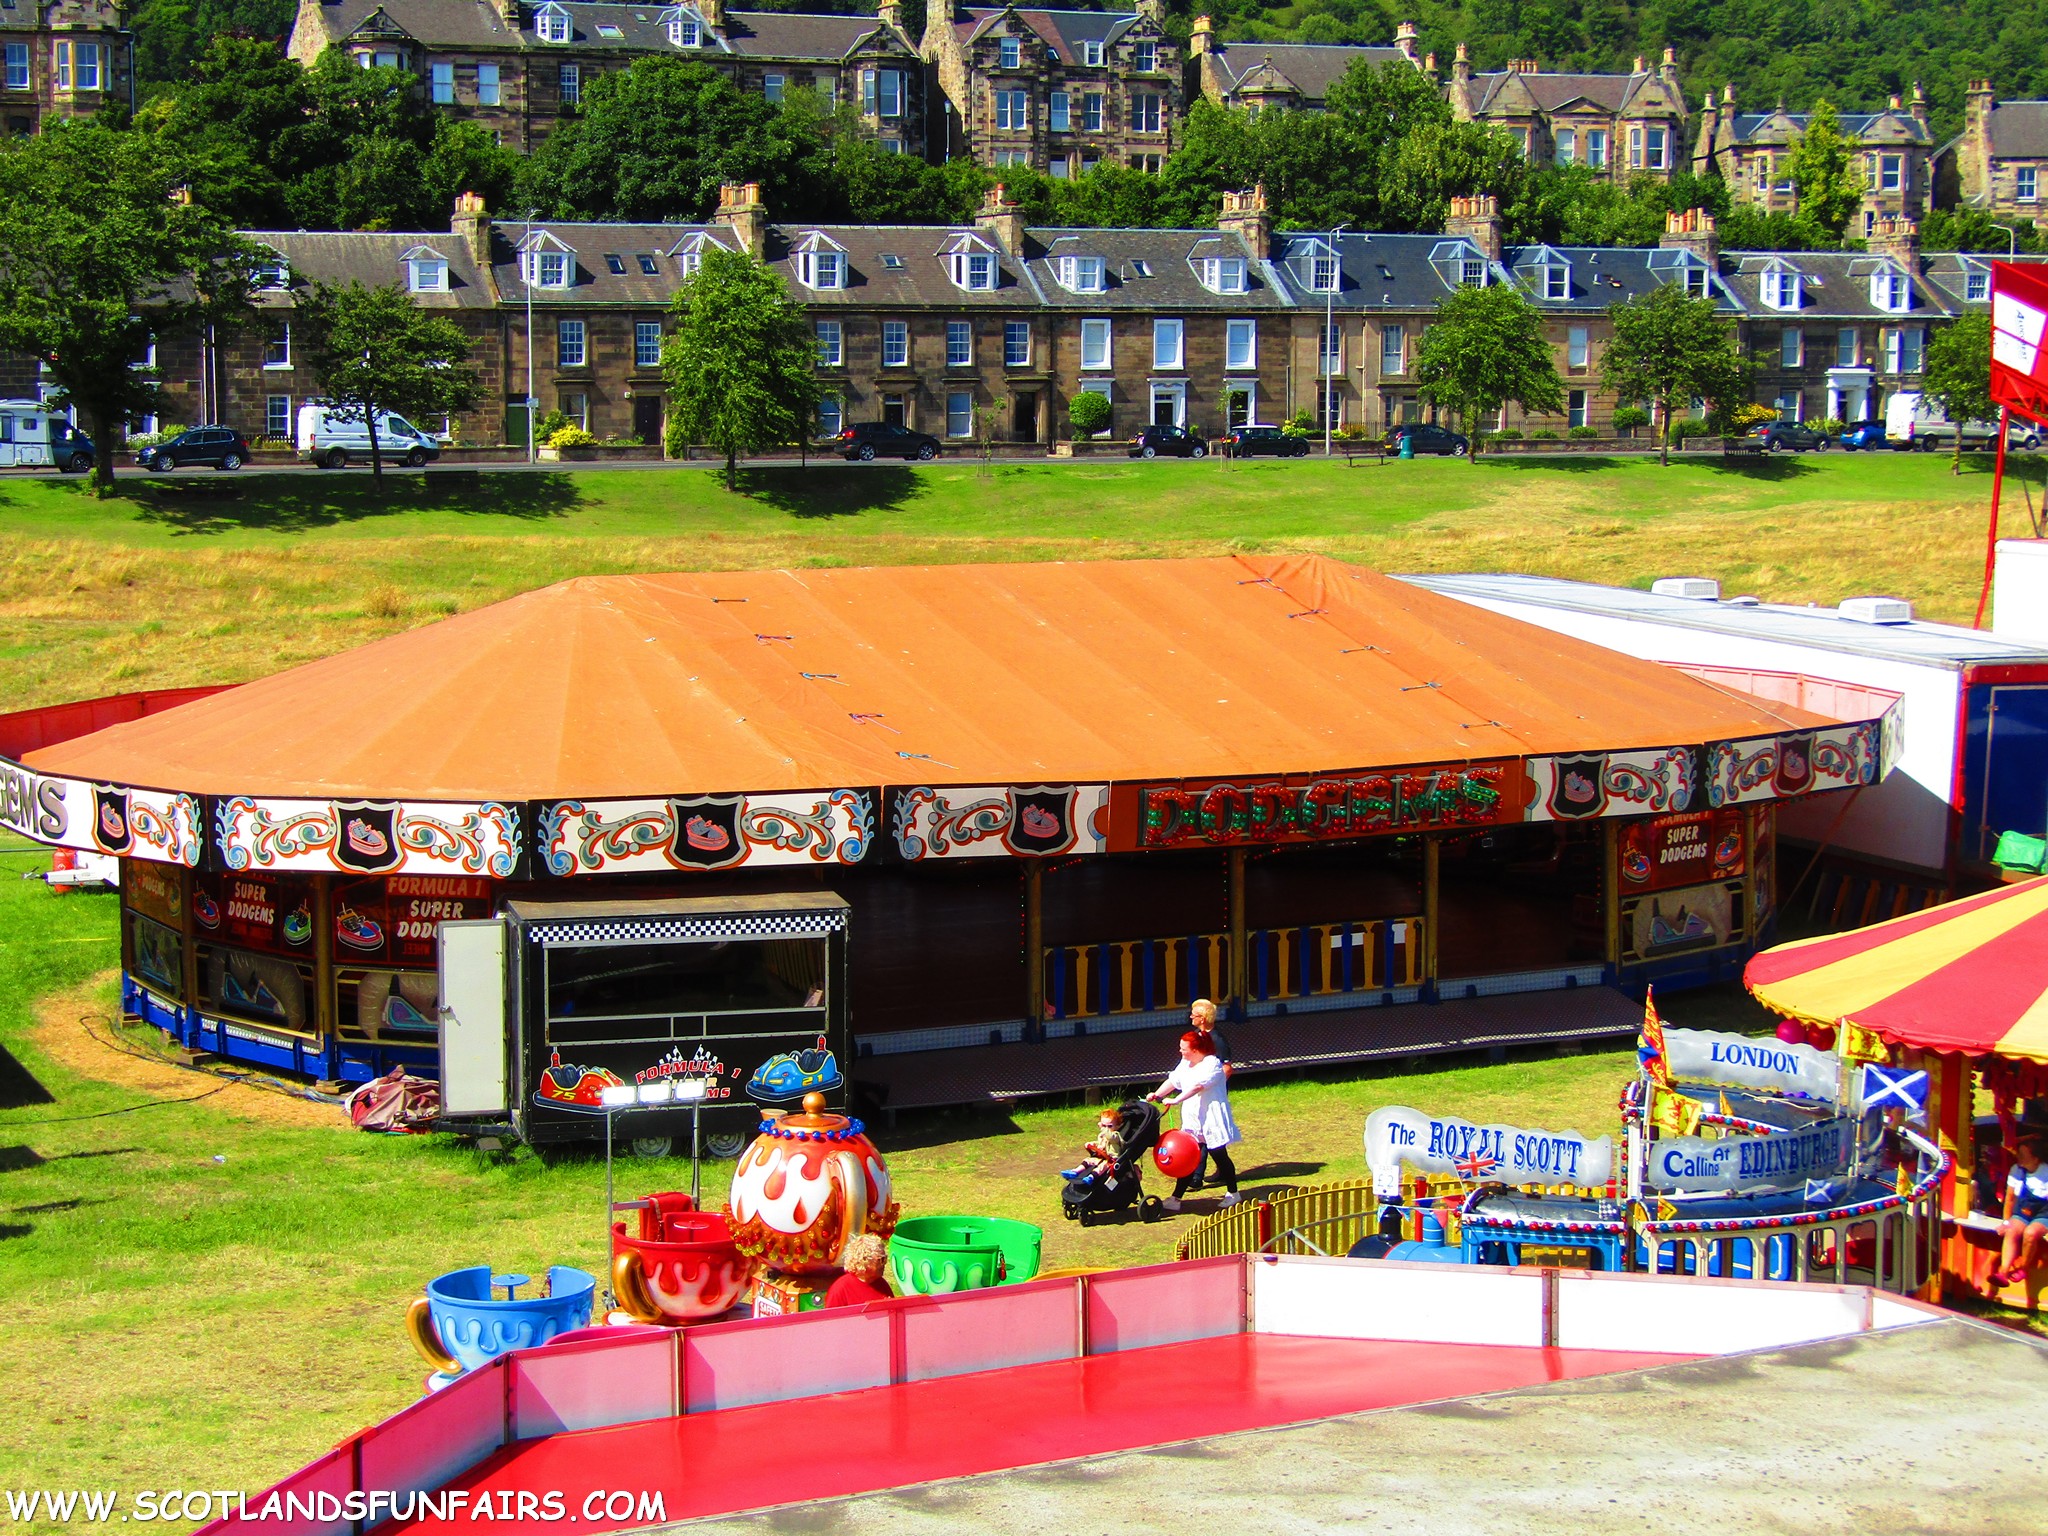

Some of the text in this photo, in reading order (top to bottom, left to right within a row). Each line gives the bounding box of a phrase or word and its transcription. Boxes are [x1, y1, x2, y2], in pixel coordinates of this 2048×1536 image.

[1136, 766, 1504, 847] DODGEMS
[1667, 825, 1699, 845] SUPER
[1660, 842, 1708, 864] DODGEMS
[234, 881, 267, 902] SUPER
[388, 877, 482, 896] FORMULA 1
[228, 901, 275, 925] DODGEMS
[410, 900, 464, 919] SUPER
[1711, 1042, 1799, 1074] LONDON
[635, 1061, 724, 1084] FORMULA
[731, 1068, 741, 1078] 1
[802, 1073, 823, 1086] 21
[551, 1089, 576, 1100] 75
[1388, 1121, 1582, 1178] The ROYAL SCOTT
[1664, 1128, 1840, 1178] Calling At EDINBURGH
